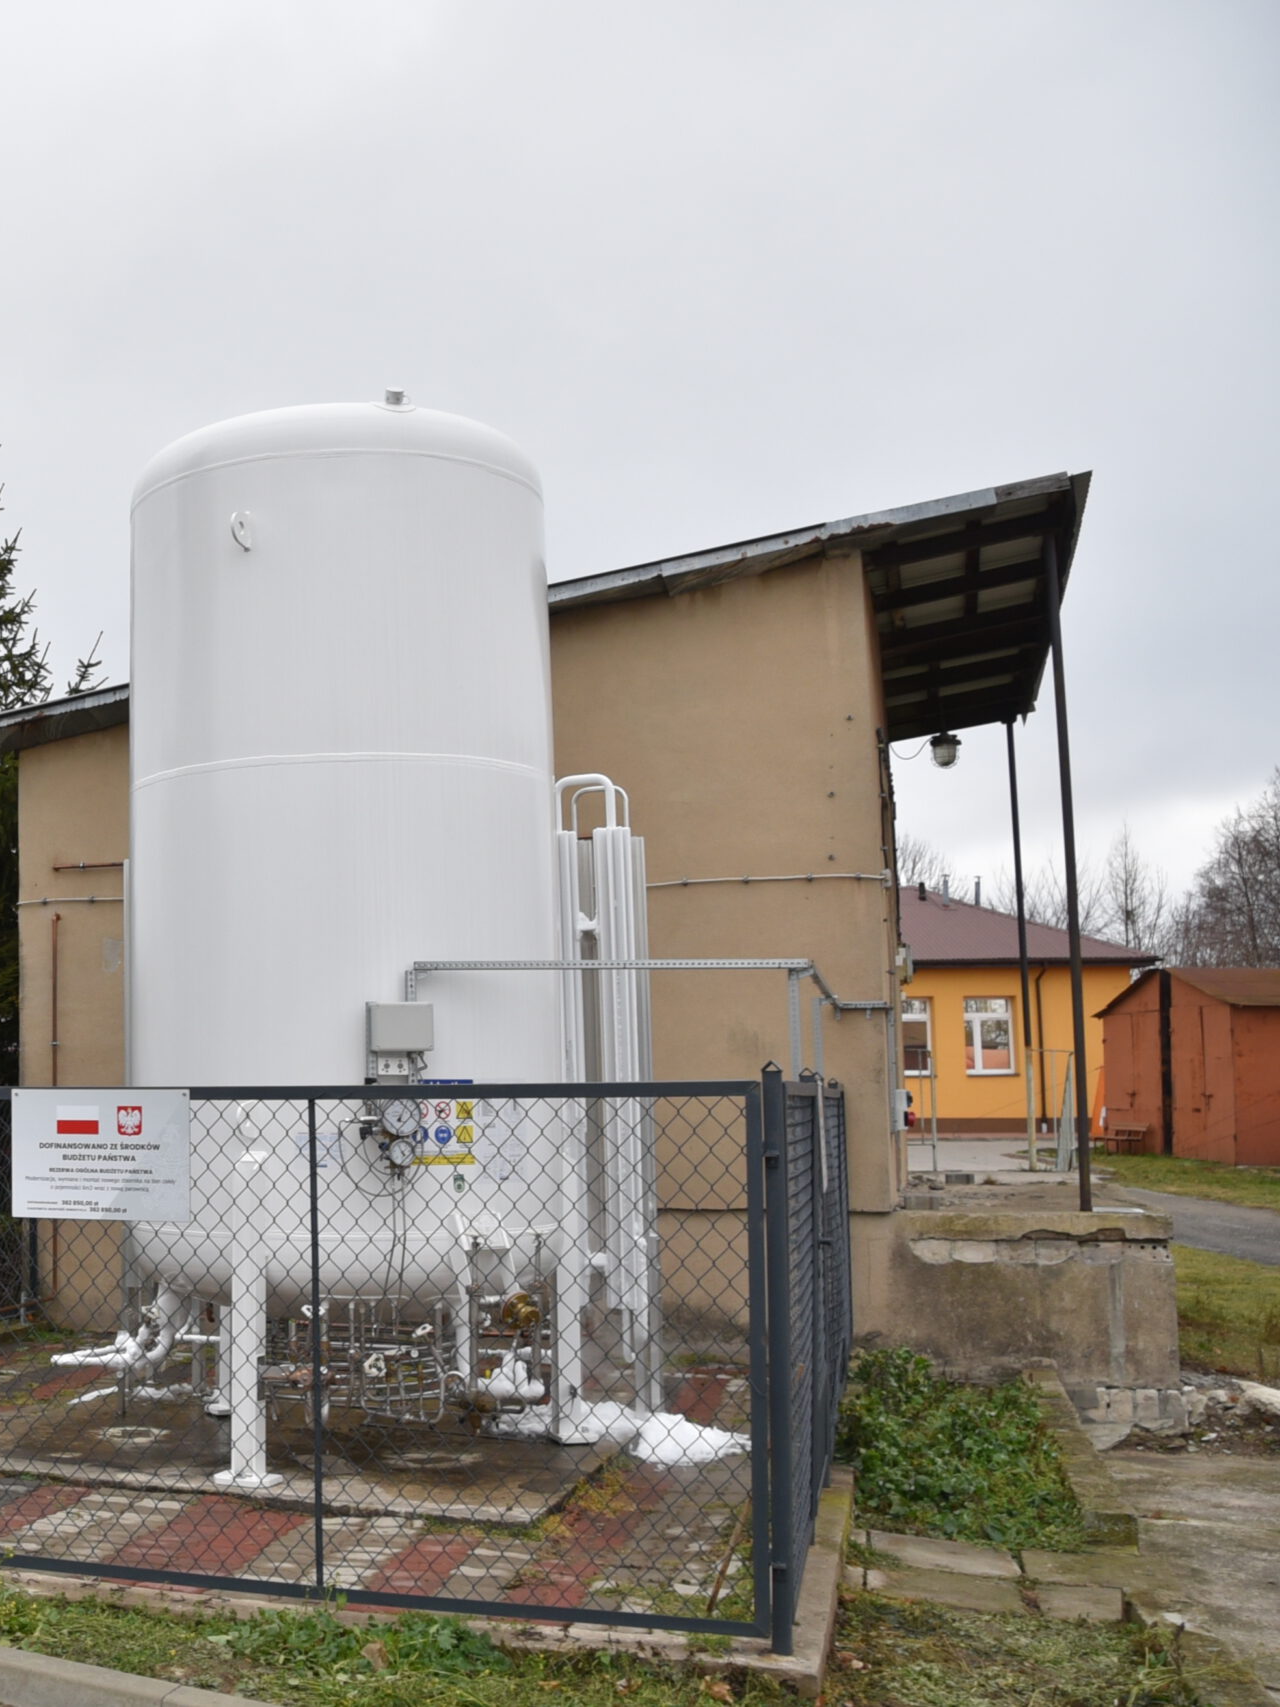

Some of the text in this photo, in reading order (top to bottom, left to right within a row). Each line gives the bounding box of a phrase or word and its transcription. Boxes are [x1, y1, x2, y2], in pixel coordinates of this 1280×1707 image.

[39, 1142, 108, 1150] DOFINANSOWANO
[120, 1141, 161, 1151] ŚRODKÓW
[62, 1152, 136, 1162] BUDŻETU PAŃSTWA
